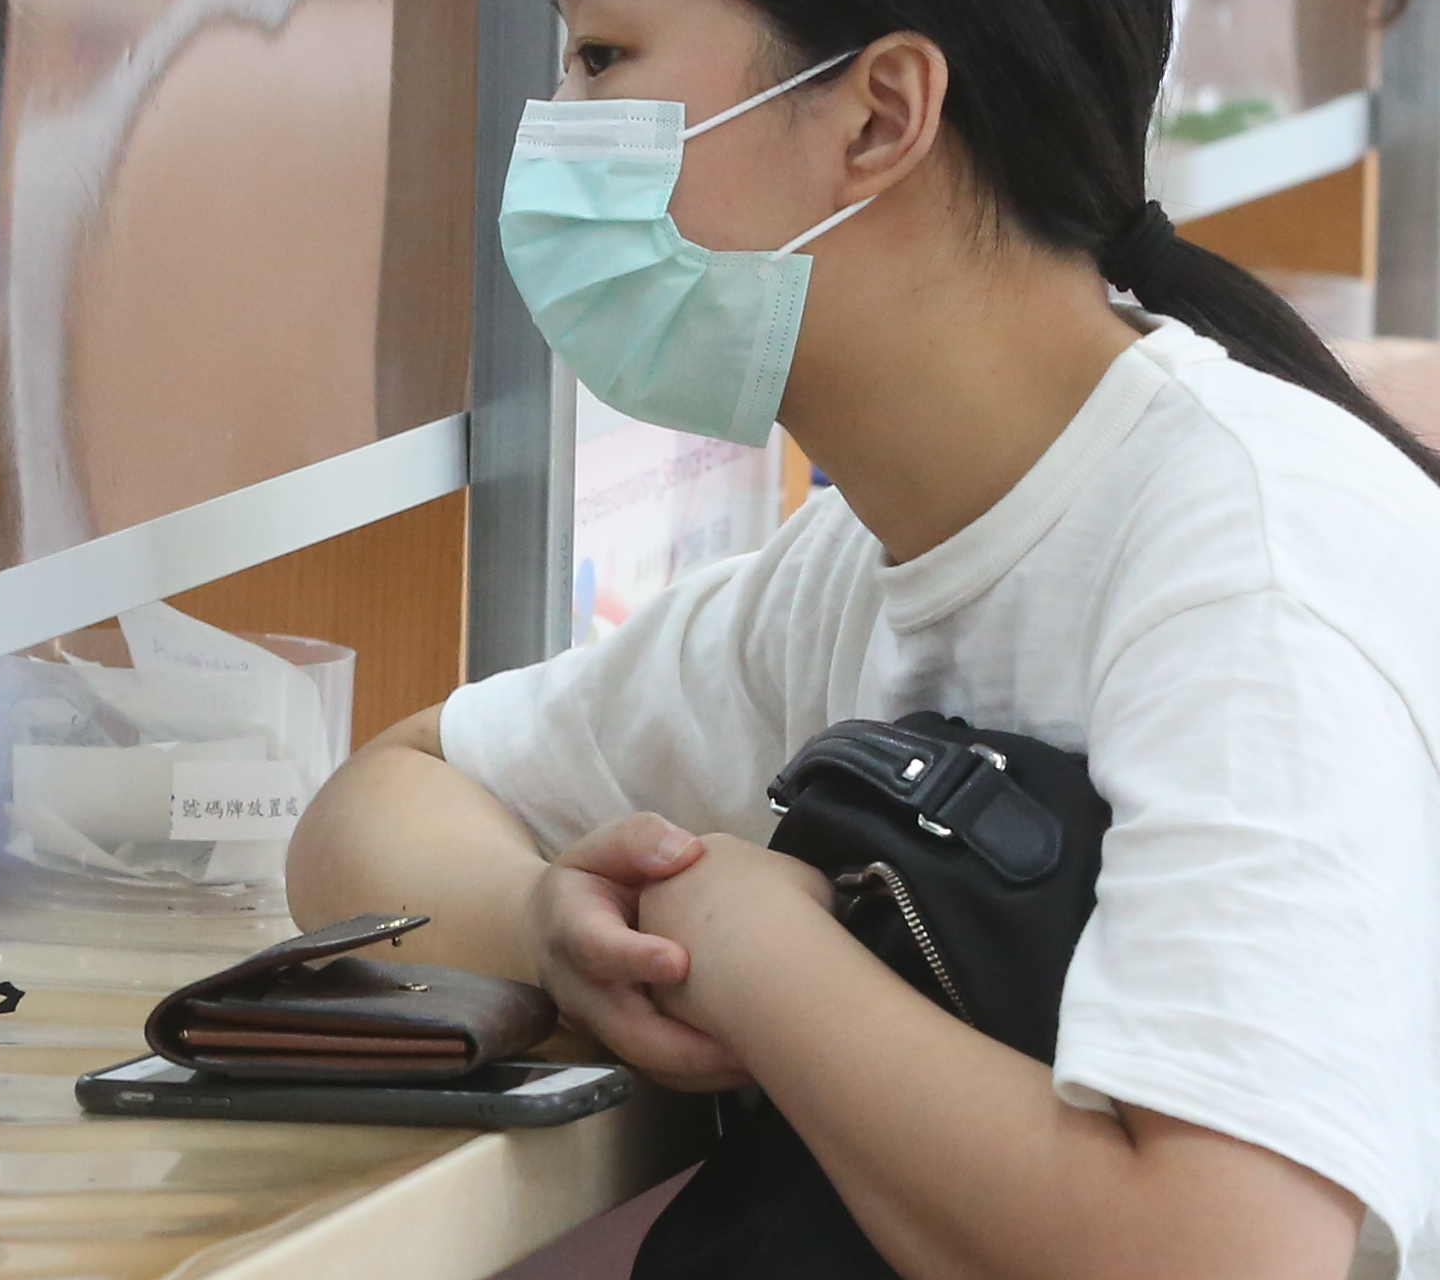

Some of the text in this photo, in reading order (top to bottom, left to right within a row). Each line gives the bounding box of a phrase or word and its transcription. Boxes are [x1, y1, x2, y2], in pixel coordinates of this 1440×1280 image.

[182, 796, 299, 819] 號碼牌放置處
